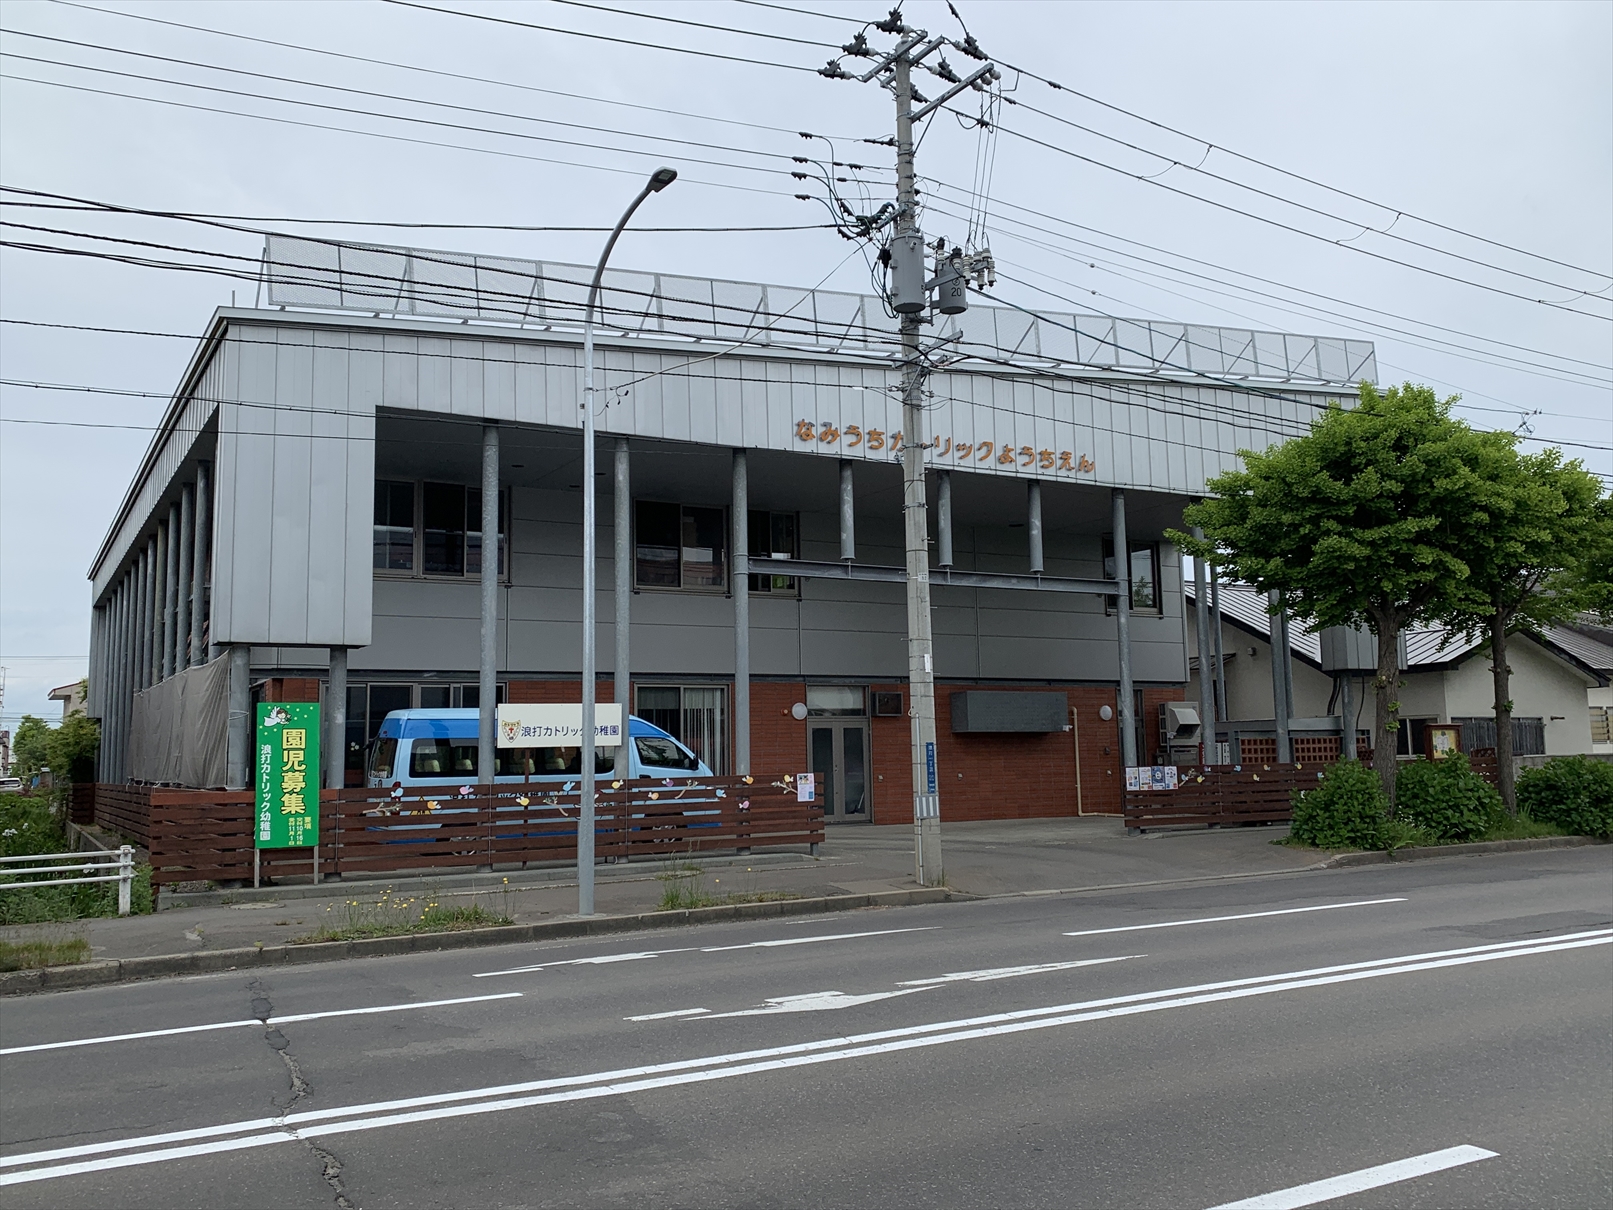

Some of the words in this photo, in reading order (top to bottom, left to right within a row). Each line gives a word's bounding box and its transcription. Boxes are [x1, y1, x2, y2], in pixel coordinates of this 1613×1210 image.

[951, 287, 962, 297] 20
[795, 418, 1095, 473] なみうちカリックようちえん
[521, 724, 620, 737] 浪打カトリッ稚園
[260, 744, 272, 841] 浪打カトリック幼稚園
[280, 728, 306, 815] 園児募集
